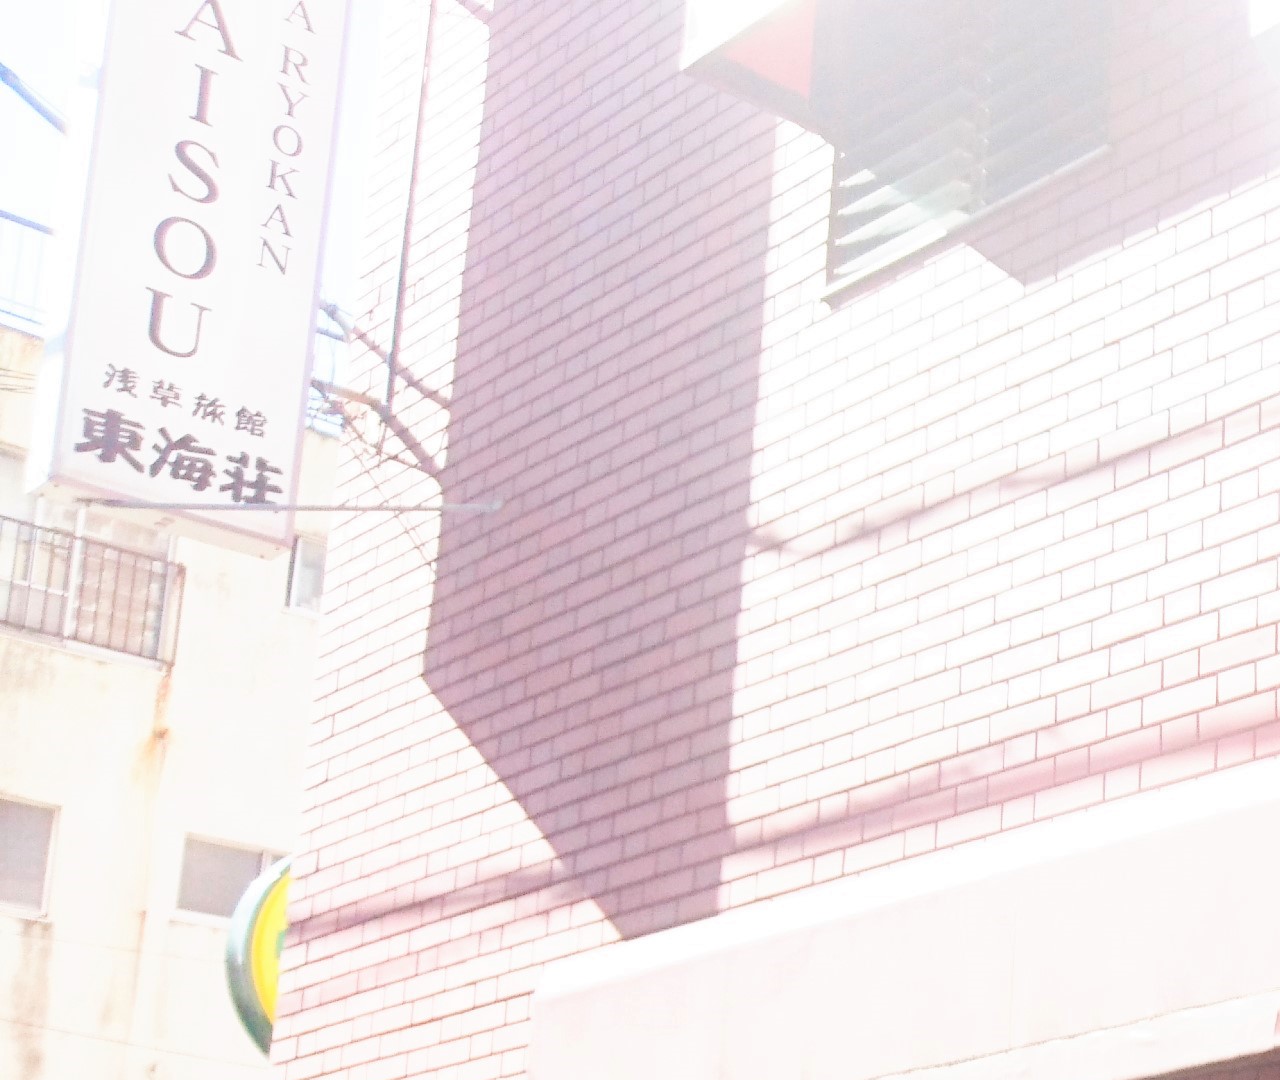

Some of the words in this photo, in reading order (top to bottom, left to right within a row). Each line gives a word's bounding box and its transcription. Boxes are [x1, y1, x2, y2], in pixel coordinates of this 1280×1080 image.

[103, 363, 268, 437] 浅草旅館
[74, 408, 284, 504] 東海荘
